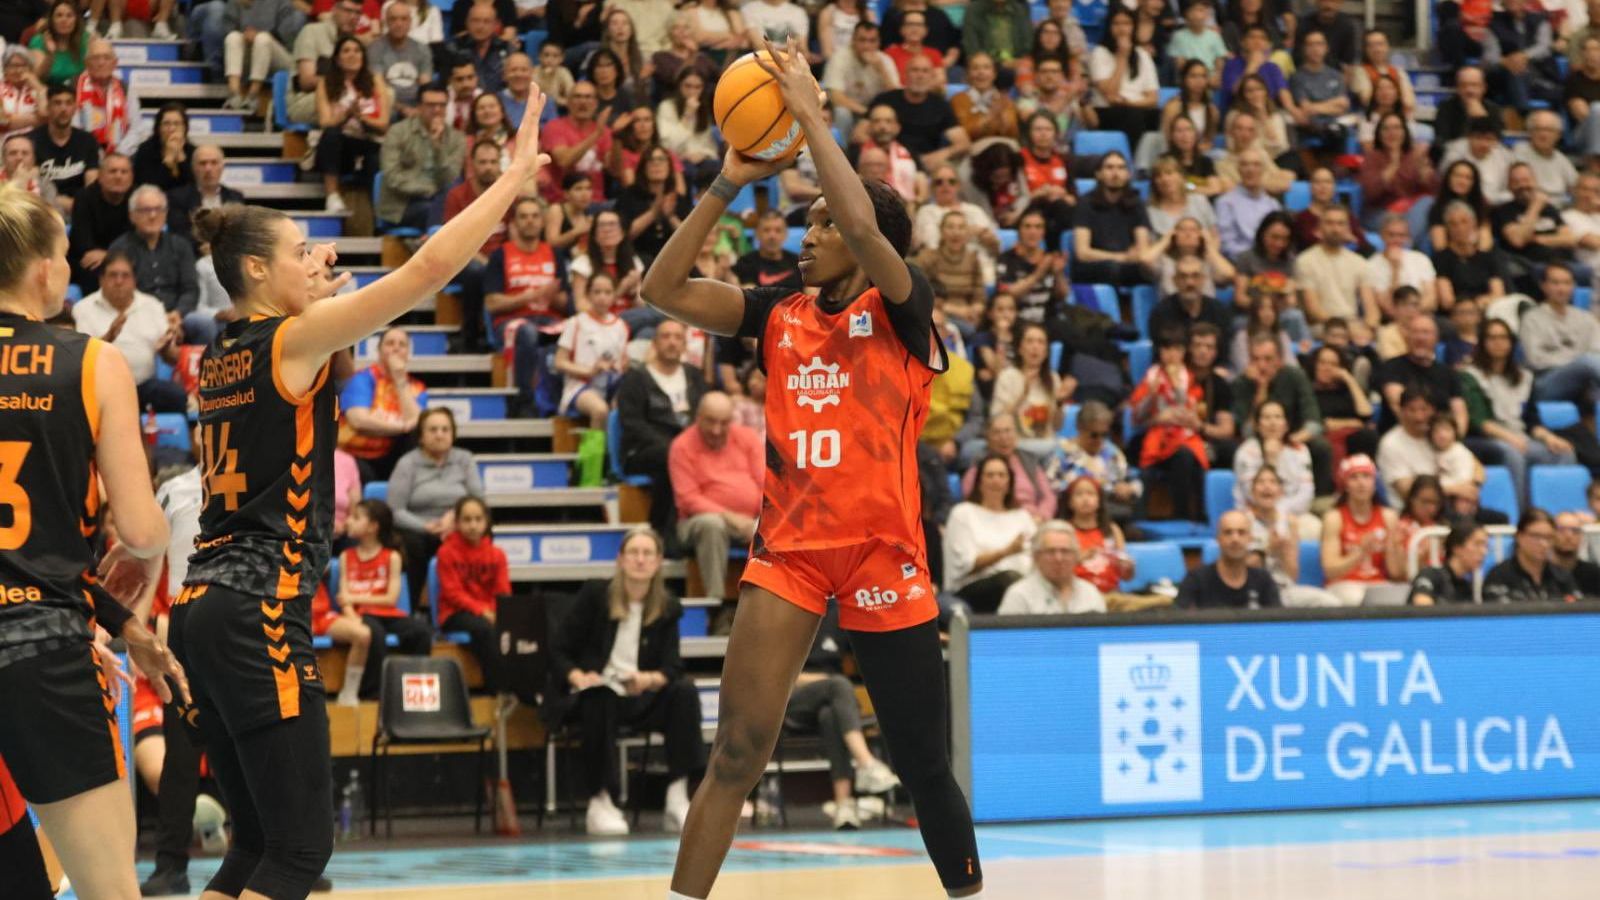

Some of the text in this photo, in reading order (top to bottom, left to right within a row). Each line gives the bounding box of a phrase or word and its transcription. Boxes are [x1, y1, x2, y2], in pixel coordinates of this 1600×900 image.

[789, 429, 841, 468] 10
[1226, 650, 1442, 711] XUNTA
[1226, 714, 1575, 782] DE GALICIA
